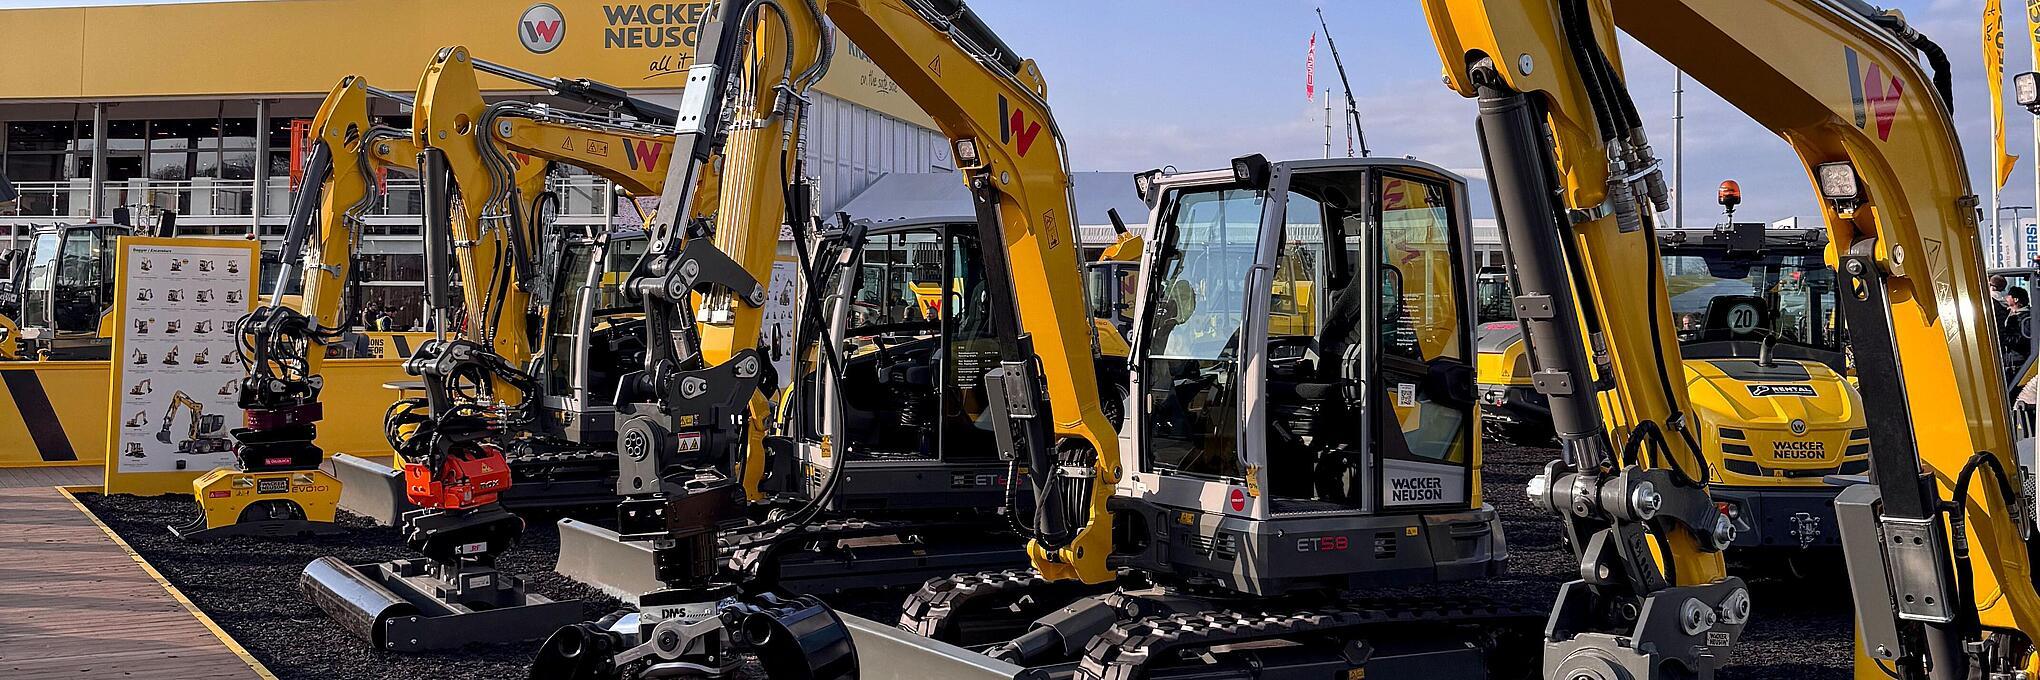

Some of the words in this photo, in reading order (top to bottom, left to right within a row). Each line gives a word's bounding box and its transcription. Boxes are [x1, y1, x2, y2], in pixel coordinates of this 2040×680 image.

[604, 26, 702, 48] NEUSO
[650, 54, 672, 71] all
[1733, 309, 1752, 328] 20
[1773, 441, 1824, 450] WACKER
[1774, 450, 1825, 459] NEUSON
[292, 485, 329, 493] EVO101
[1391, 477, 1442, 489] WACKER
[1392, 489, 1442, 501] NEUSON
[1297, 536, 1349, 552] ET58
[661, 608, 686, 619] DMS
